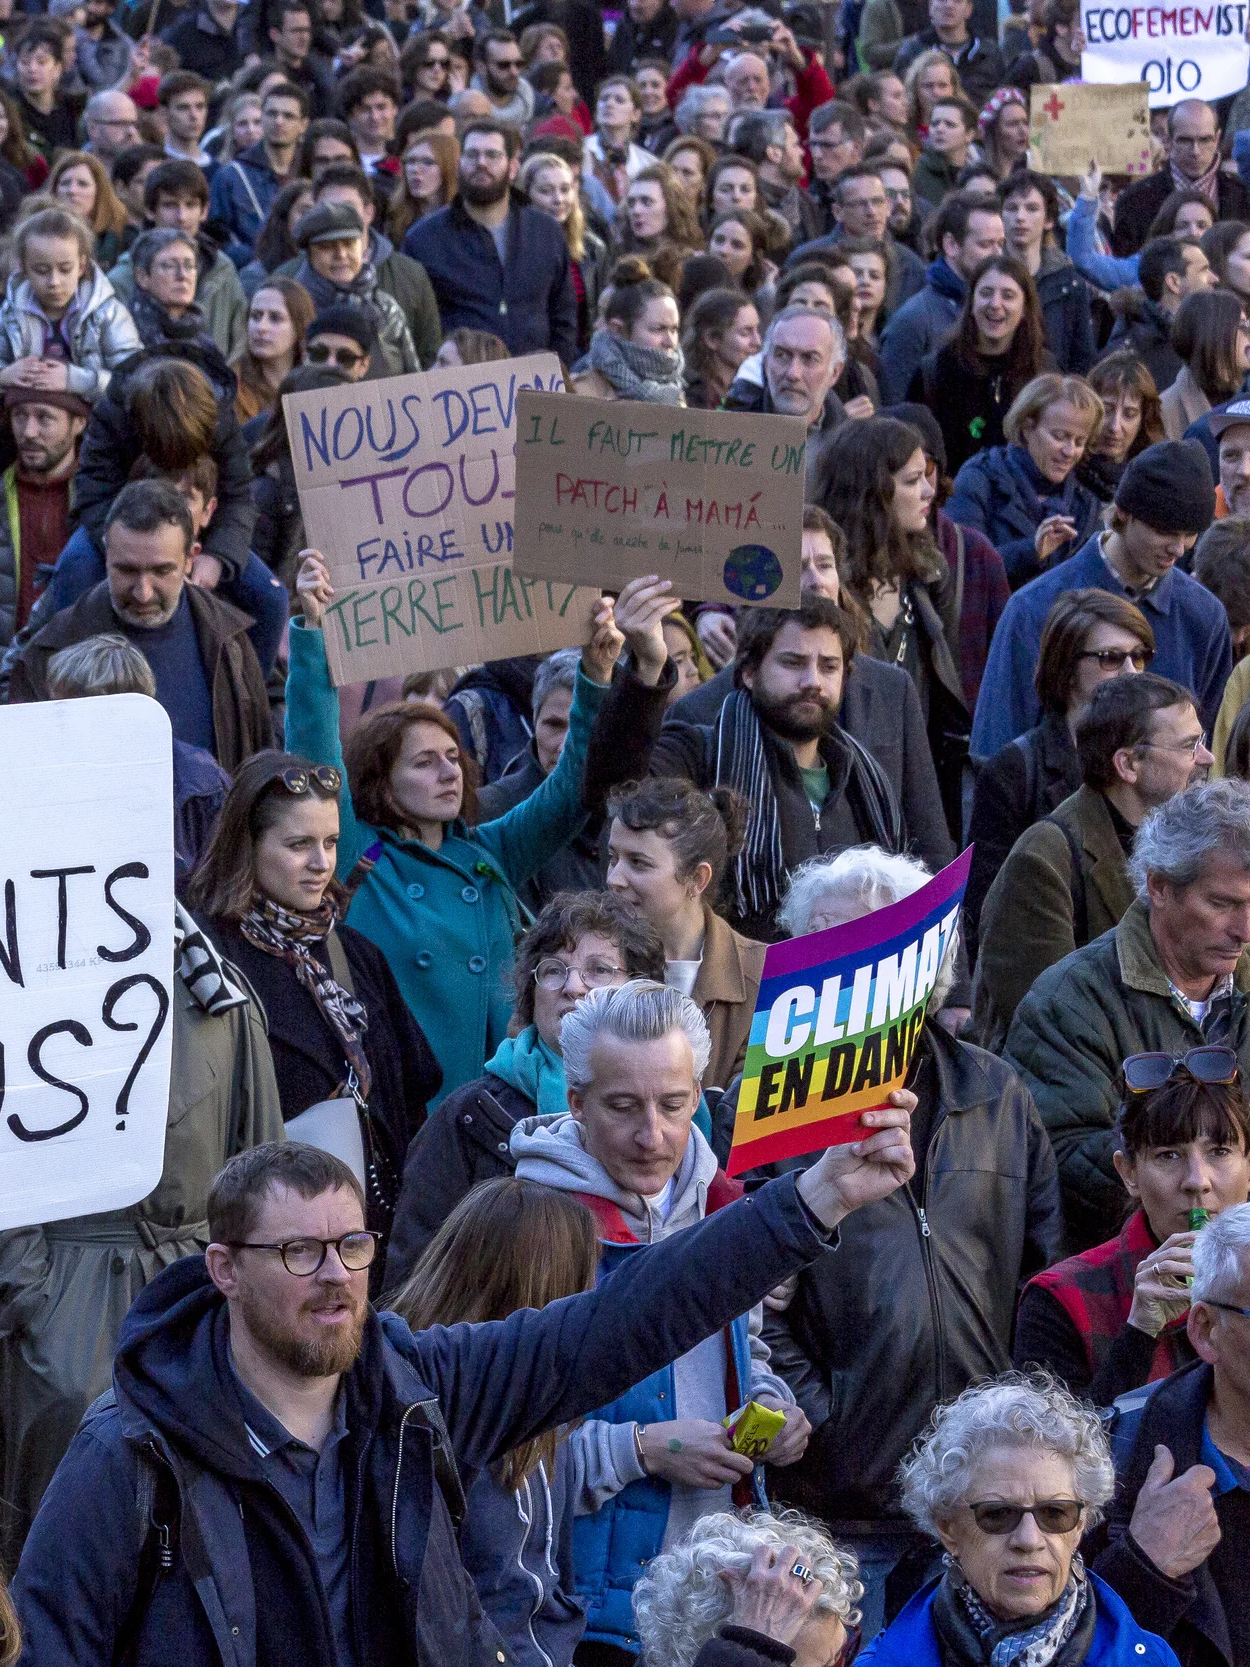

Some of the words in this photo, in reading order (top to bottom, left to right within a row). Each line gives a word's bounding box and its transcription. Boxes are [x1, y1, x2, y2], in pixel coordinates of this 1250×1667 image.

[300, 395, 420, 473] NOUS
[432, 374, 565, 449] DEV
[525, 415, 565, 447] IL
[587, 420, 659, 458] FAUT
[670, 429, 757, 468] METTRE
[770, 440, 807, 475] UN
[339, 442, 517, 525] TOU
[555, 472, 638, 516] PATCH
[324, 575, 464, 654] TERRE
[36, 958, 86, 973] 4359344
[753, 1051, 817, 1122] EN
